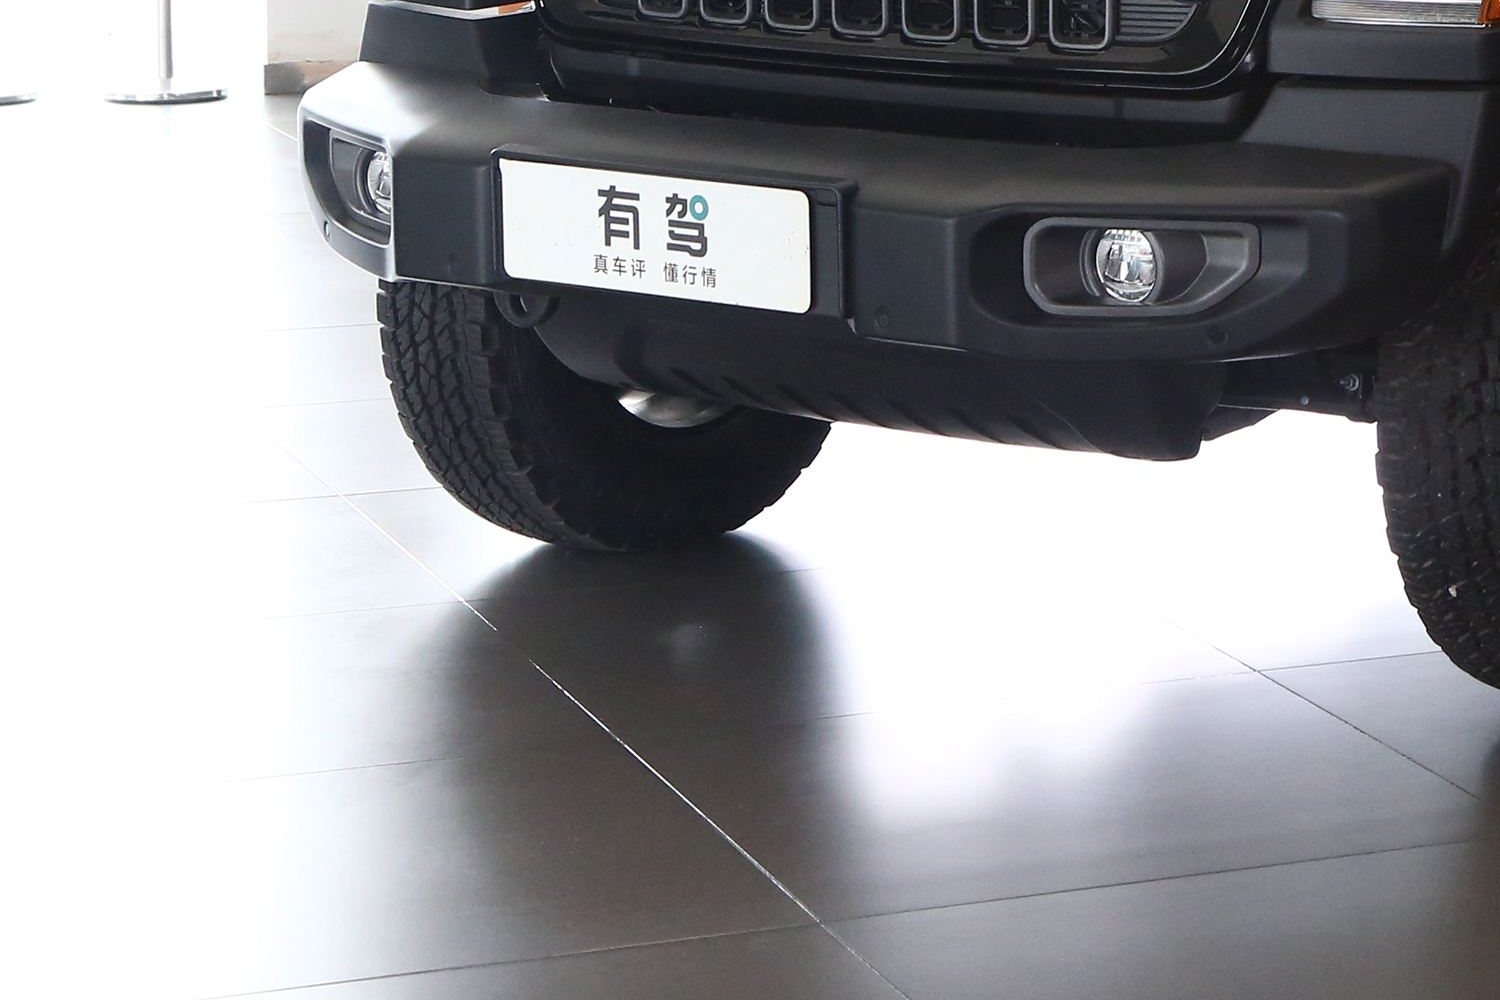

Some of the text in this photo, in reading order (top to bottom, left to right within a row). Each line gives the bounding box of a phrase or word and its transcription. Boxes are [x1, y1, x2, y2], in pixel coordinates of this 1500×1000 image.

[593, 254, 717, 288] 真车评 懂行情
